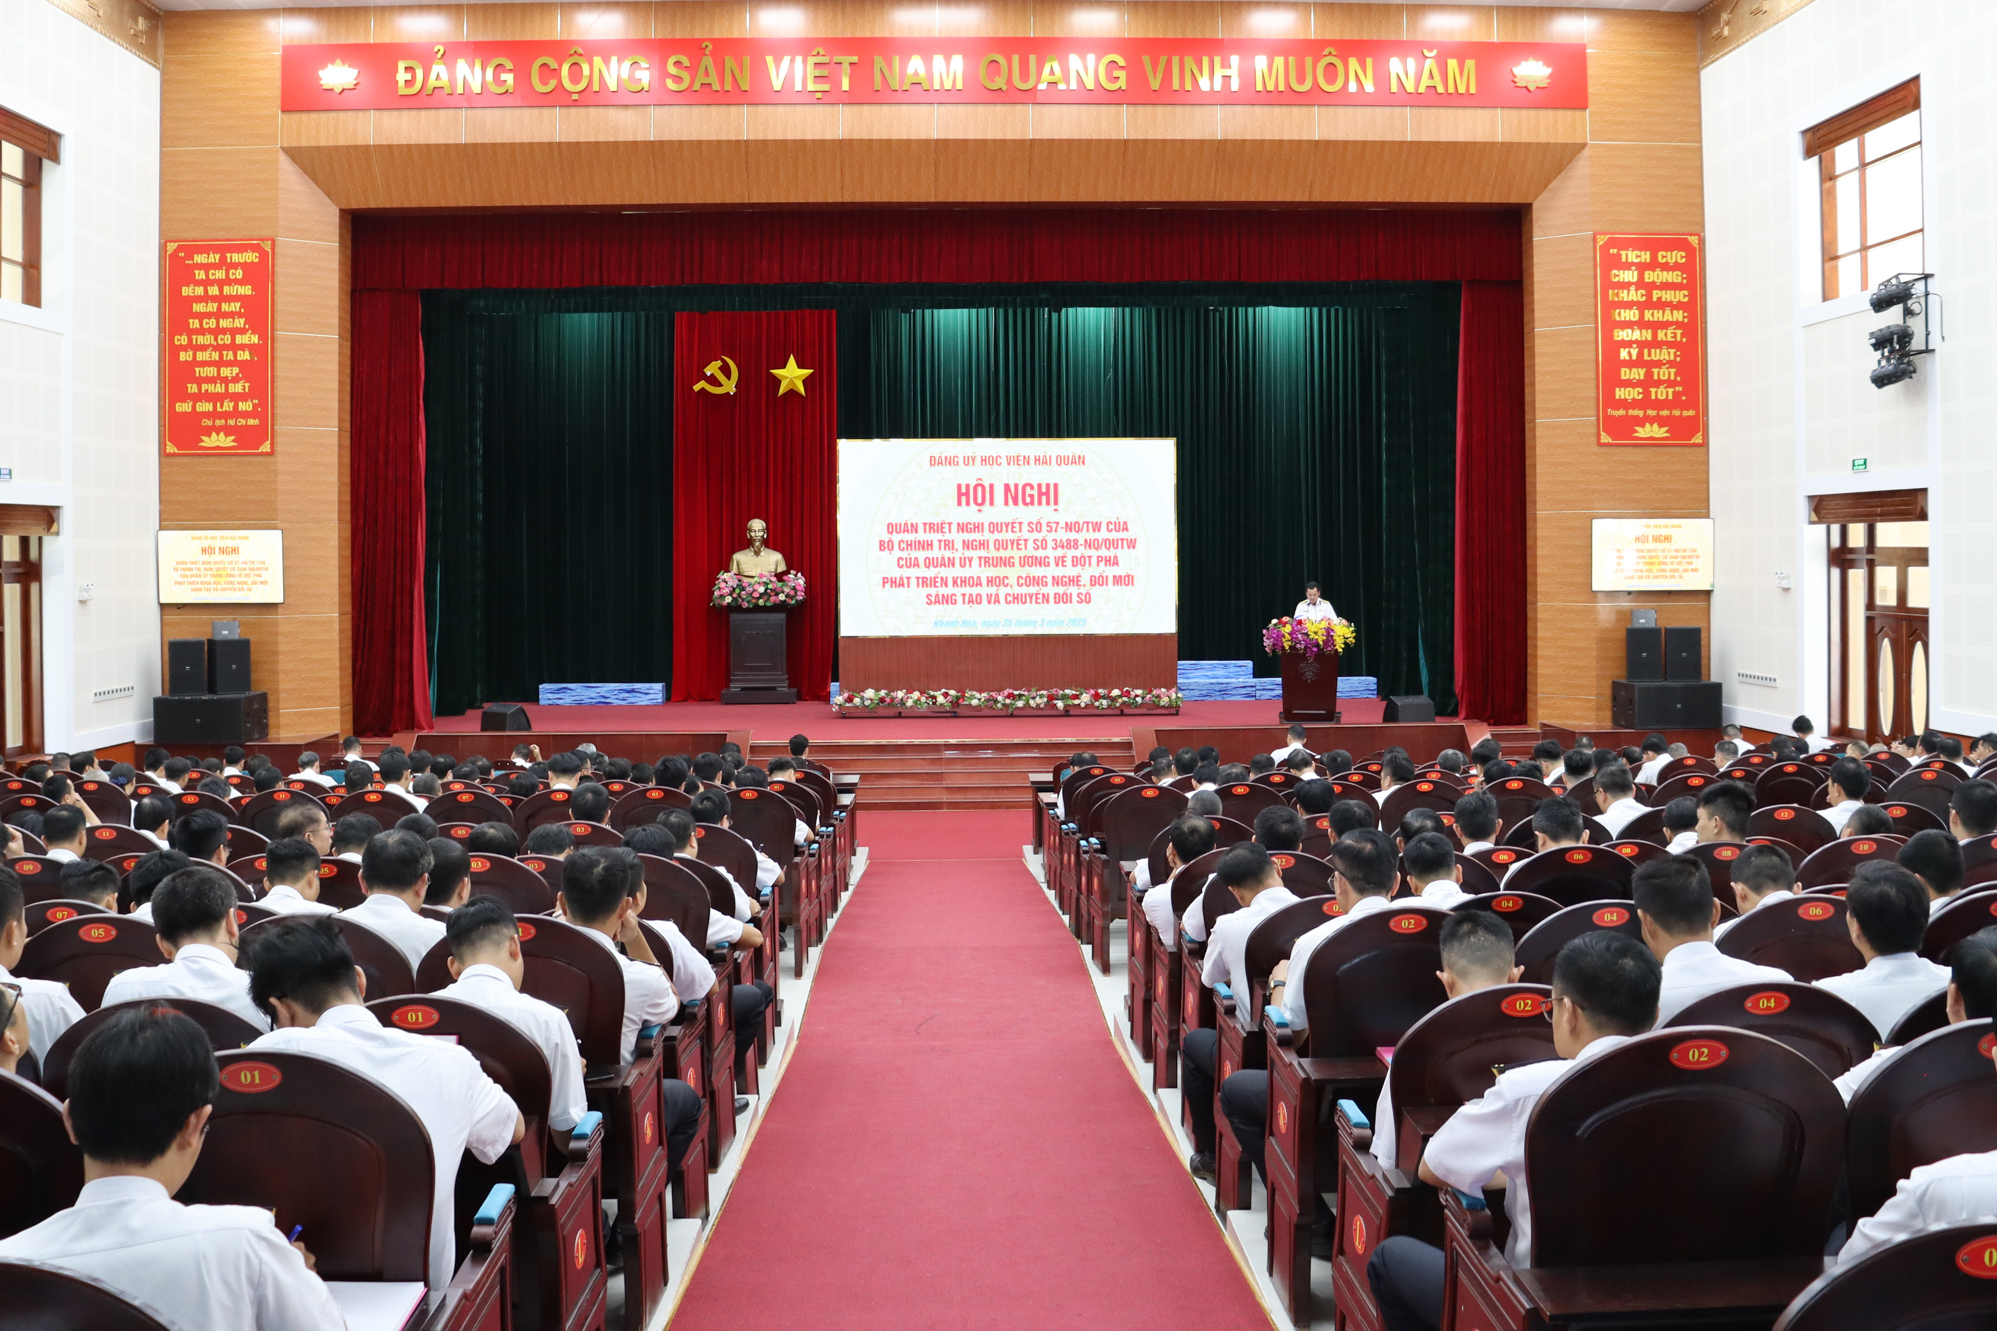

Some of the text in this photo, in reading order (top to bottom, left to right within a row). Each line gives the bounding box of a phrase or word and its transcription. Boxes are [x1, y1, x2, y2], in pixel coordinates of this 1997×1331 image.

[396, 42, 1477, 100] ĐẢNG CỘNG SẢN VIỆT NAM QUANG VINH MUÔN NĂM
[226, 250, 259, 262] TRƯỚC
[1658, 250, 1686, 265] CỰC
[194, 266, 242, 279] TA CHỈ CÓ
[1610, 266, 1686, 285] CHỦ ĐỘNG;
[182, 283, 255, 296] ĐÊM VÀ RỪNG.
[1609, 285, 1689, 304] KHẮC PHỤC
[192, 300, 244, 312] NGÀY NAY,
[1611, 306, 1688, 322] KHÓ KHĂN;
[188, 316, 248, 328] TA CÓ NGÀY,
[174, 330, 262, 345] CÓ TRỜI, CÓ BIỂN.
[1613, 326, 1686, 342] ĐOÀN KẾT,
[179, 349, 193, 361] BỜ
[196, 347, 219, 361] BIỂN
[222, 351, 234, 360] TA
[1620, 344, 1680, 362] KỶ LUẬT;
[194, 366, 242, 380] TƯƠI ĐẸP,
[1620, 364, 1680, 382] DẠY TỐT,
[187, 380, 250, 393] TA PHẢI BIẾT
[1615, 388, 1643, 402] HỌC
[176, 400, 192, 412] GIỮ
[196, 400, 213, 412] GÌN
[216, 399, 234, 412] LẤY
[929, 452, 960, 466] ĐẢNG
[980, 455, 1002, 469] HỌC
[1006, 452, 1030, 468] VIỆN
[1034, 451, 1052, 466] HẢI
[1056, 452, 1086, 467] QUÂN
[956, 478, 1058, 512] HỘI NGHỊ
[887, 517, 1129, 536] QUÁN TRIỆT NGHỊ QUYẾT SỐ 57-NQ/TW CỦA
[879, 534, 1137, 554] BỘ CHÍNH TRỊ, NGHỊ QUYẾT SỐ 3488-NQ/QUTW
[1634, 532, 1672, 546] HỘI NGHỊ
[201, 544, 240, 558] HỘI NGHỊ
[897, 553, 920, 568] CỦA
[924, 554, 955, 570] QUÂN
[978, 556, 1015, 568] TRUNG
[1019, 554, 1050, 568] ƯƠNG
[1054, 552, 1067, 567] VỀ
[1071, 553, 1093, 570] ĐỘT
[1096, 552, 1119, 567] PHÁ
[882, 574, 912, 588] PHÁT
[915, 571, 948, 588] TRIỂN
[952, 576, 982, 588] KHOA
[1016, 573, 1048, 587] CÔNG
[1052, 573, 1086, 590] NGHỆ,
[1090, 570, 1108, 586] ĐỔI
[1112, 572, 1134, 586] MỚI
[926, 588, 1091, 608] SÁNG TẠO VÀ CHUYỂN ĐỔI SỐ
[56, 911, 69, 921] 07
[1604, 913, 1617, 921] 04
[1809, 907, 1822, 915] 06
[1402, 919, 1414, 928] 02
[91, 928, 105, 937] 05
[1516, 1000, 1532, 1010] 02
[1760, 998, 1775, 1008] 04
[408, 1012, 422, 1022] 01
[1689, 1048, 1708, 1061] 02
[241, 1070, 260, 1084] 01
